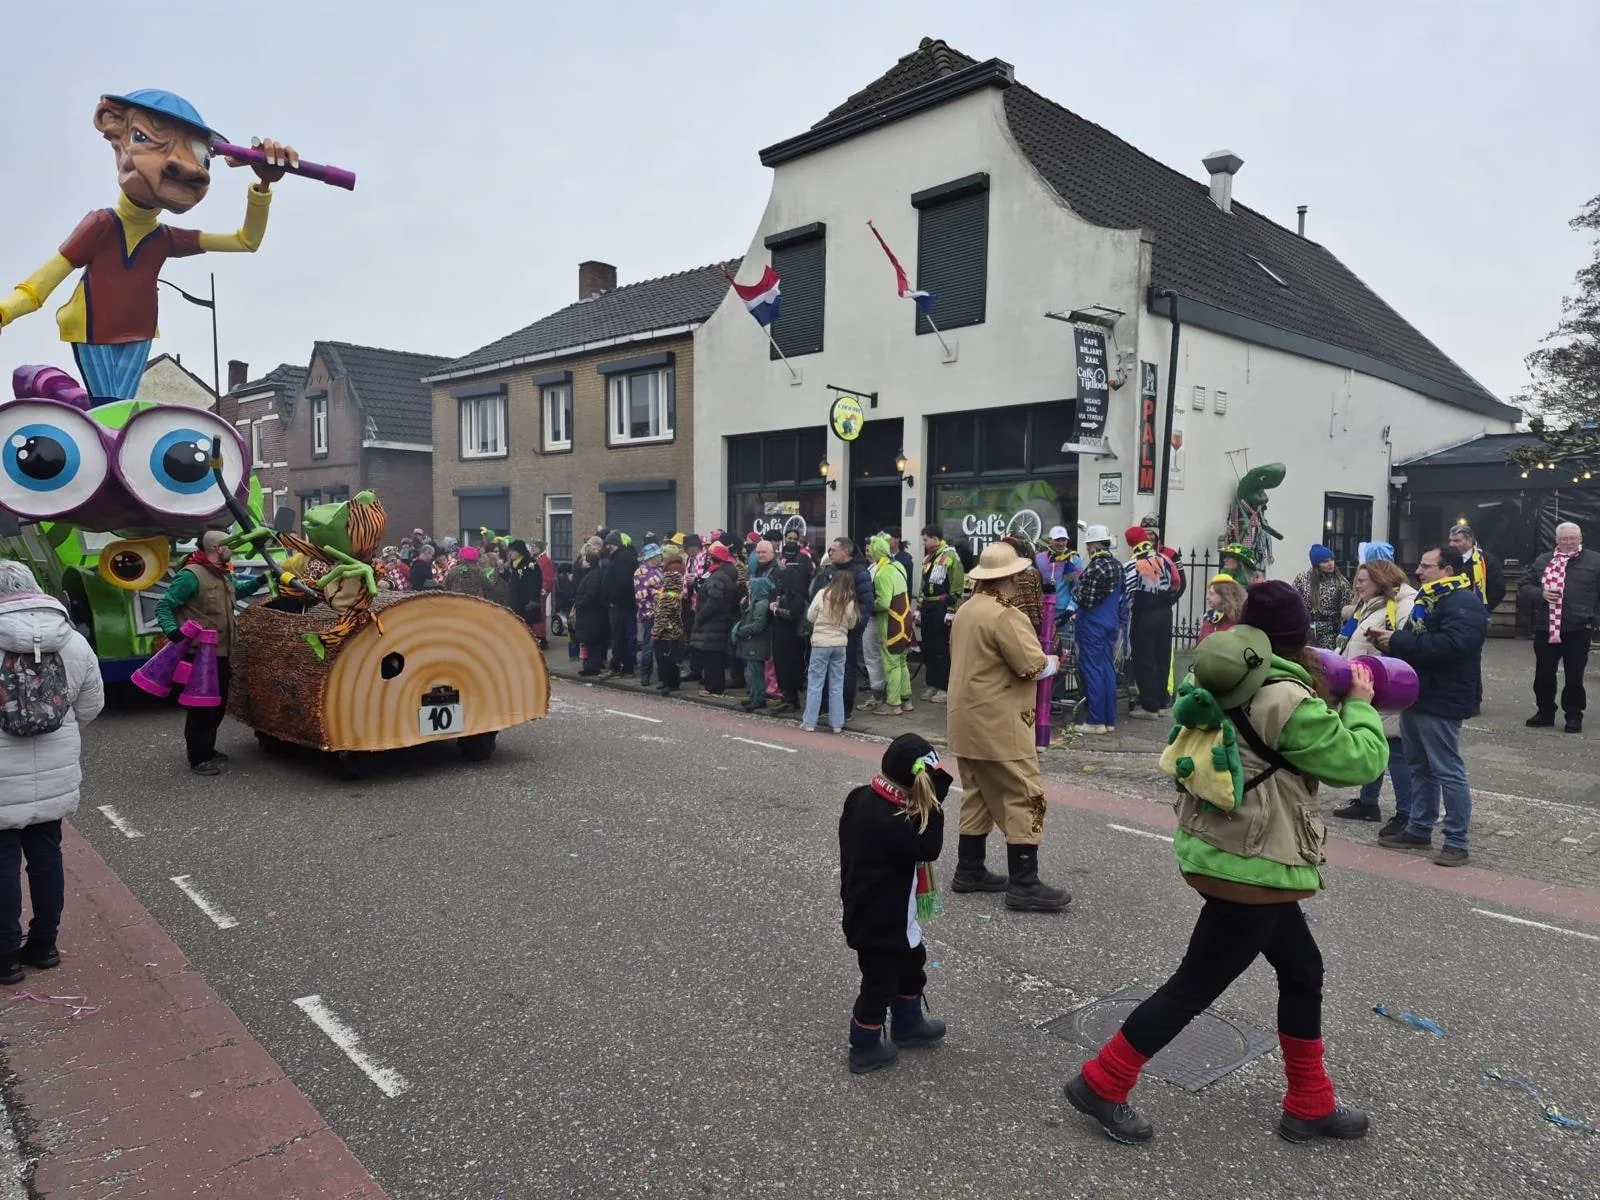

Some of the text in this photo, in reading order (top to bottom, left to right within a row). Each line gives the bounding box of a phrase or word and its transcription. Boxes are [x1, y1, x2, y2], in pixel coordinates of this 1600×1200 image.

[1079, 346, 1103, 356] BILJART
[1084, 356, 1100, 365] ZAAL
[1085, 405, 1098, 414] ZAAL
[1140, 399, 1153, 489] PALM
[753, 518, 783, 536] Café
[961, 513, 1006, 536] Café
[428, 707, 452, 731] 10
